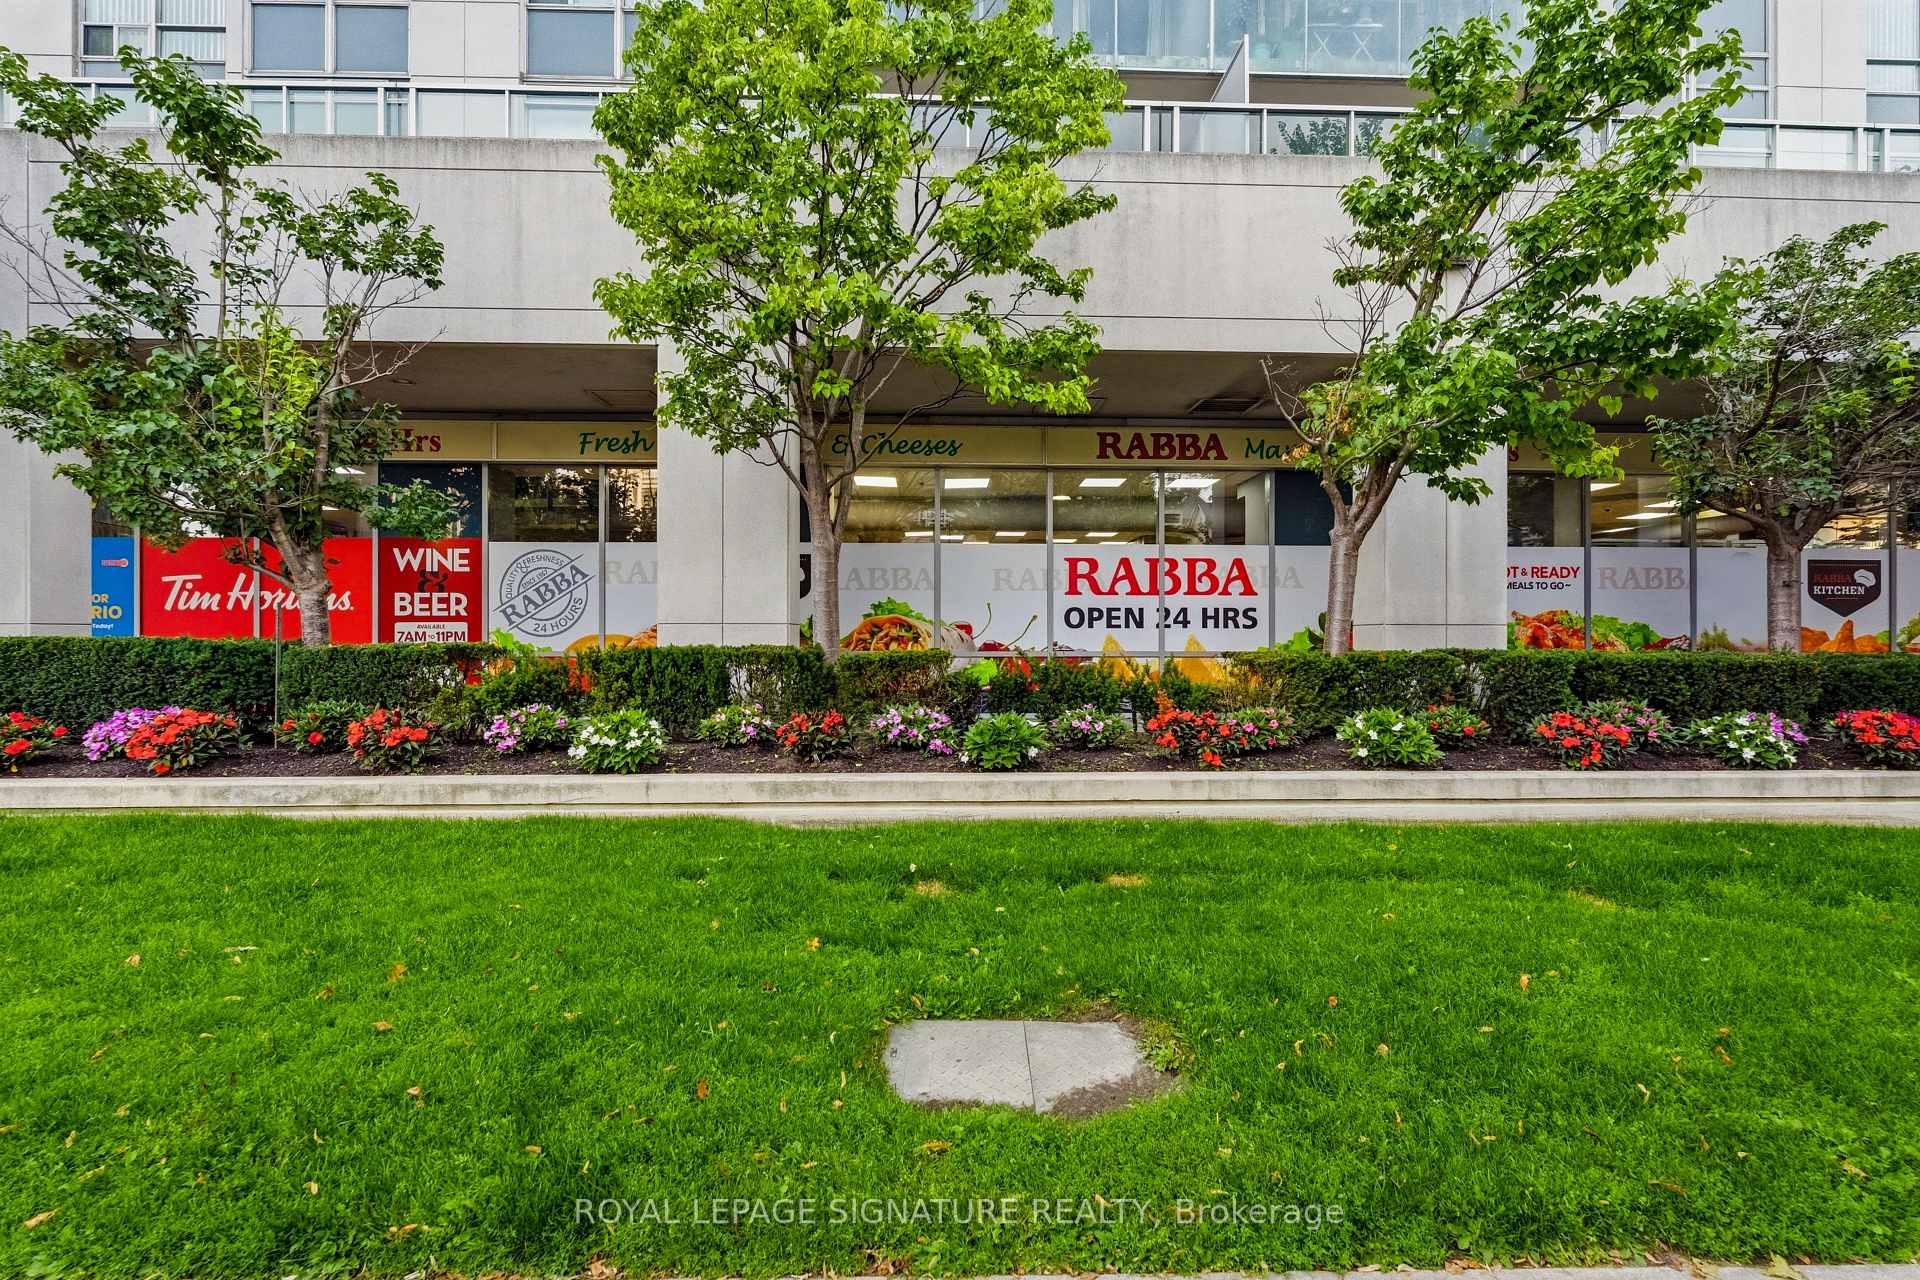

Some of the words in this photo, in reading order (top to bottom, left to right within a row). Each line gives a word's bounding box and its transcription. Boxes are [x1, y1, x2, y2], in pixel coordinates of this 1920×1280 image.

[579, 430, 656, 455] Fresh
[861, 431, 963, 456] Cheeses
[1096, 431, 1228, 460] RABBA
[393, 547, 470, 572] WINE
[523, 554, 565, 568] FRESHNESS
[839, 568, 934, 591] ABBA
[1064, 557, 1258, 596] RABBA
[1521, 567, 1528, 576] &
[1531, 566, 1580, 578] READY
[1597, 567, 1690, 590] RABB
[162, 574, 221, 611] Tim
[500, 564, 589, 626] RABBA
[1536, 582, 1548, 590] TO
[1813, 585, 1865, 595] KITCHEN
[394, 592, 468, 616] BEER
[534, 623, 547, 632] 24
[551, 597, 584, 632] HOURS
[1063, 606, 1144, 630] OPEN
[1156, 607, 1191, 629] 24
[1201, 606, 1258, 630] HRS
[397, 631, 427, 642] 7AM
[436, 631, 466, 642] 11PM
